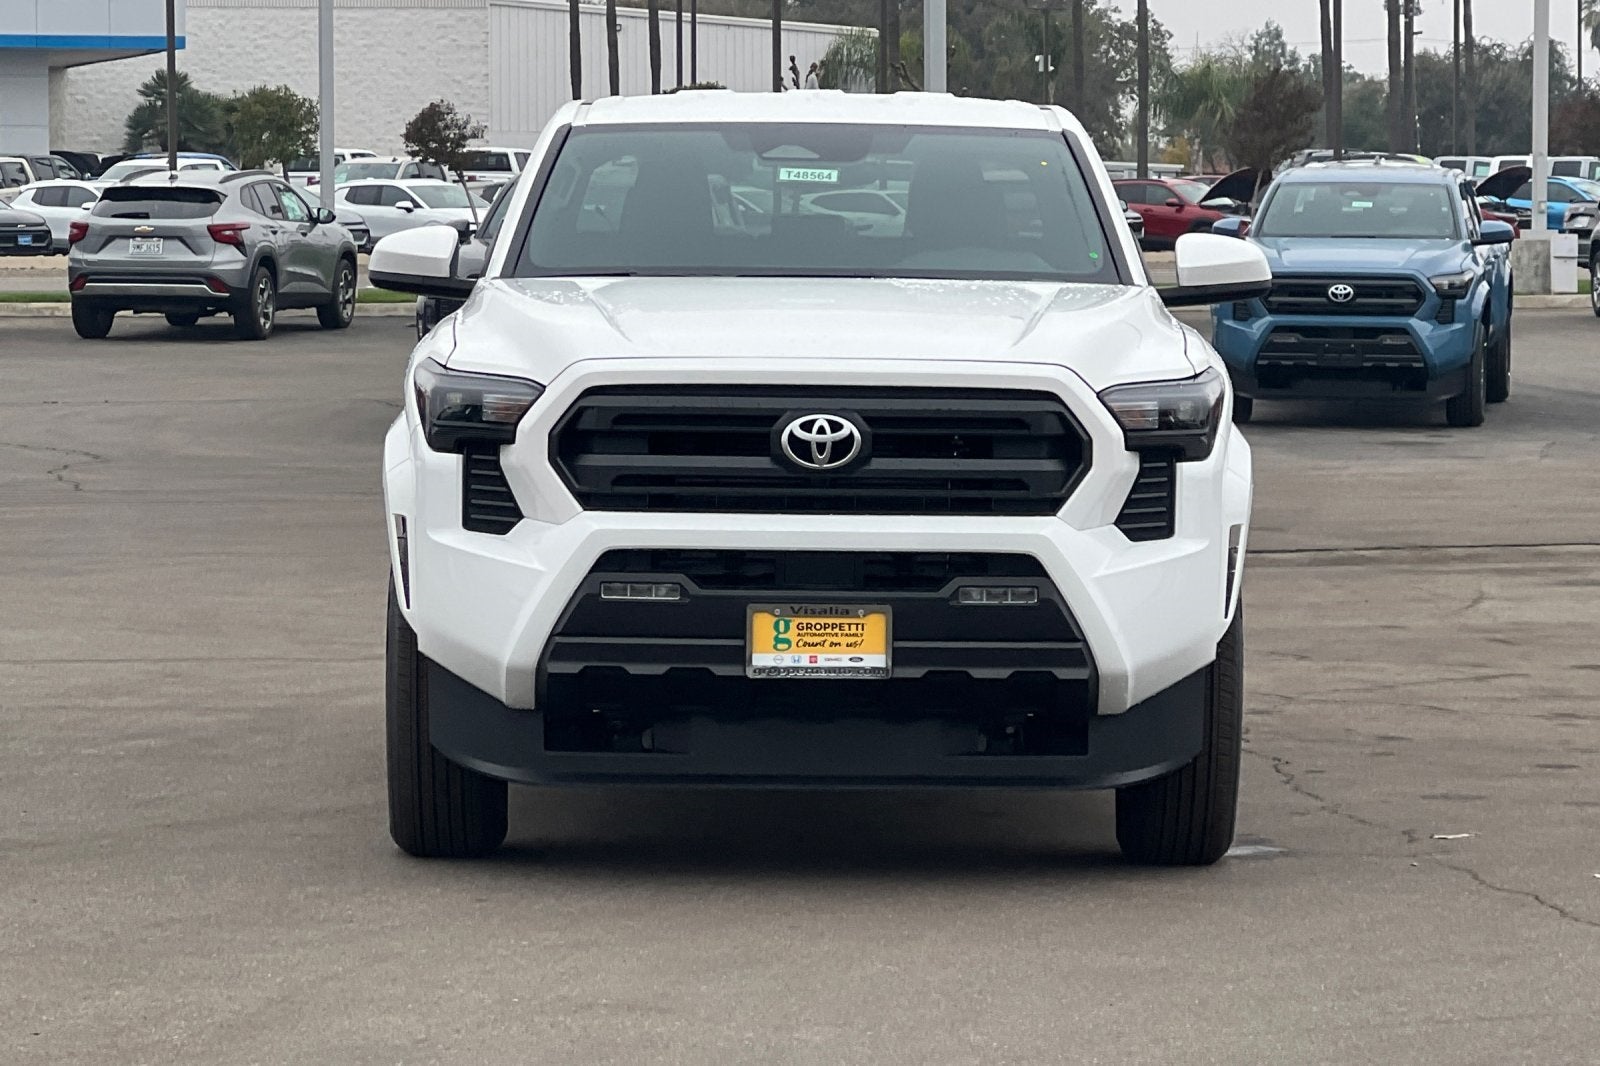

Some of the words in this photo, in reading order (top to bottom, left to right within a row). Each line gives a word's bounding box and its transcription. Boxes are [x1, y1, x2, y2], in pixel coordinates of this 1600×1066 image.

[785, 170, 832, 180] T48564
[789, 605, 850, 616] Visalia
[796, 622, 865, 632] GROPPETTI
[796, 638, 827, 648] Count
[845, 638, 864, 648] us!
